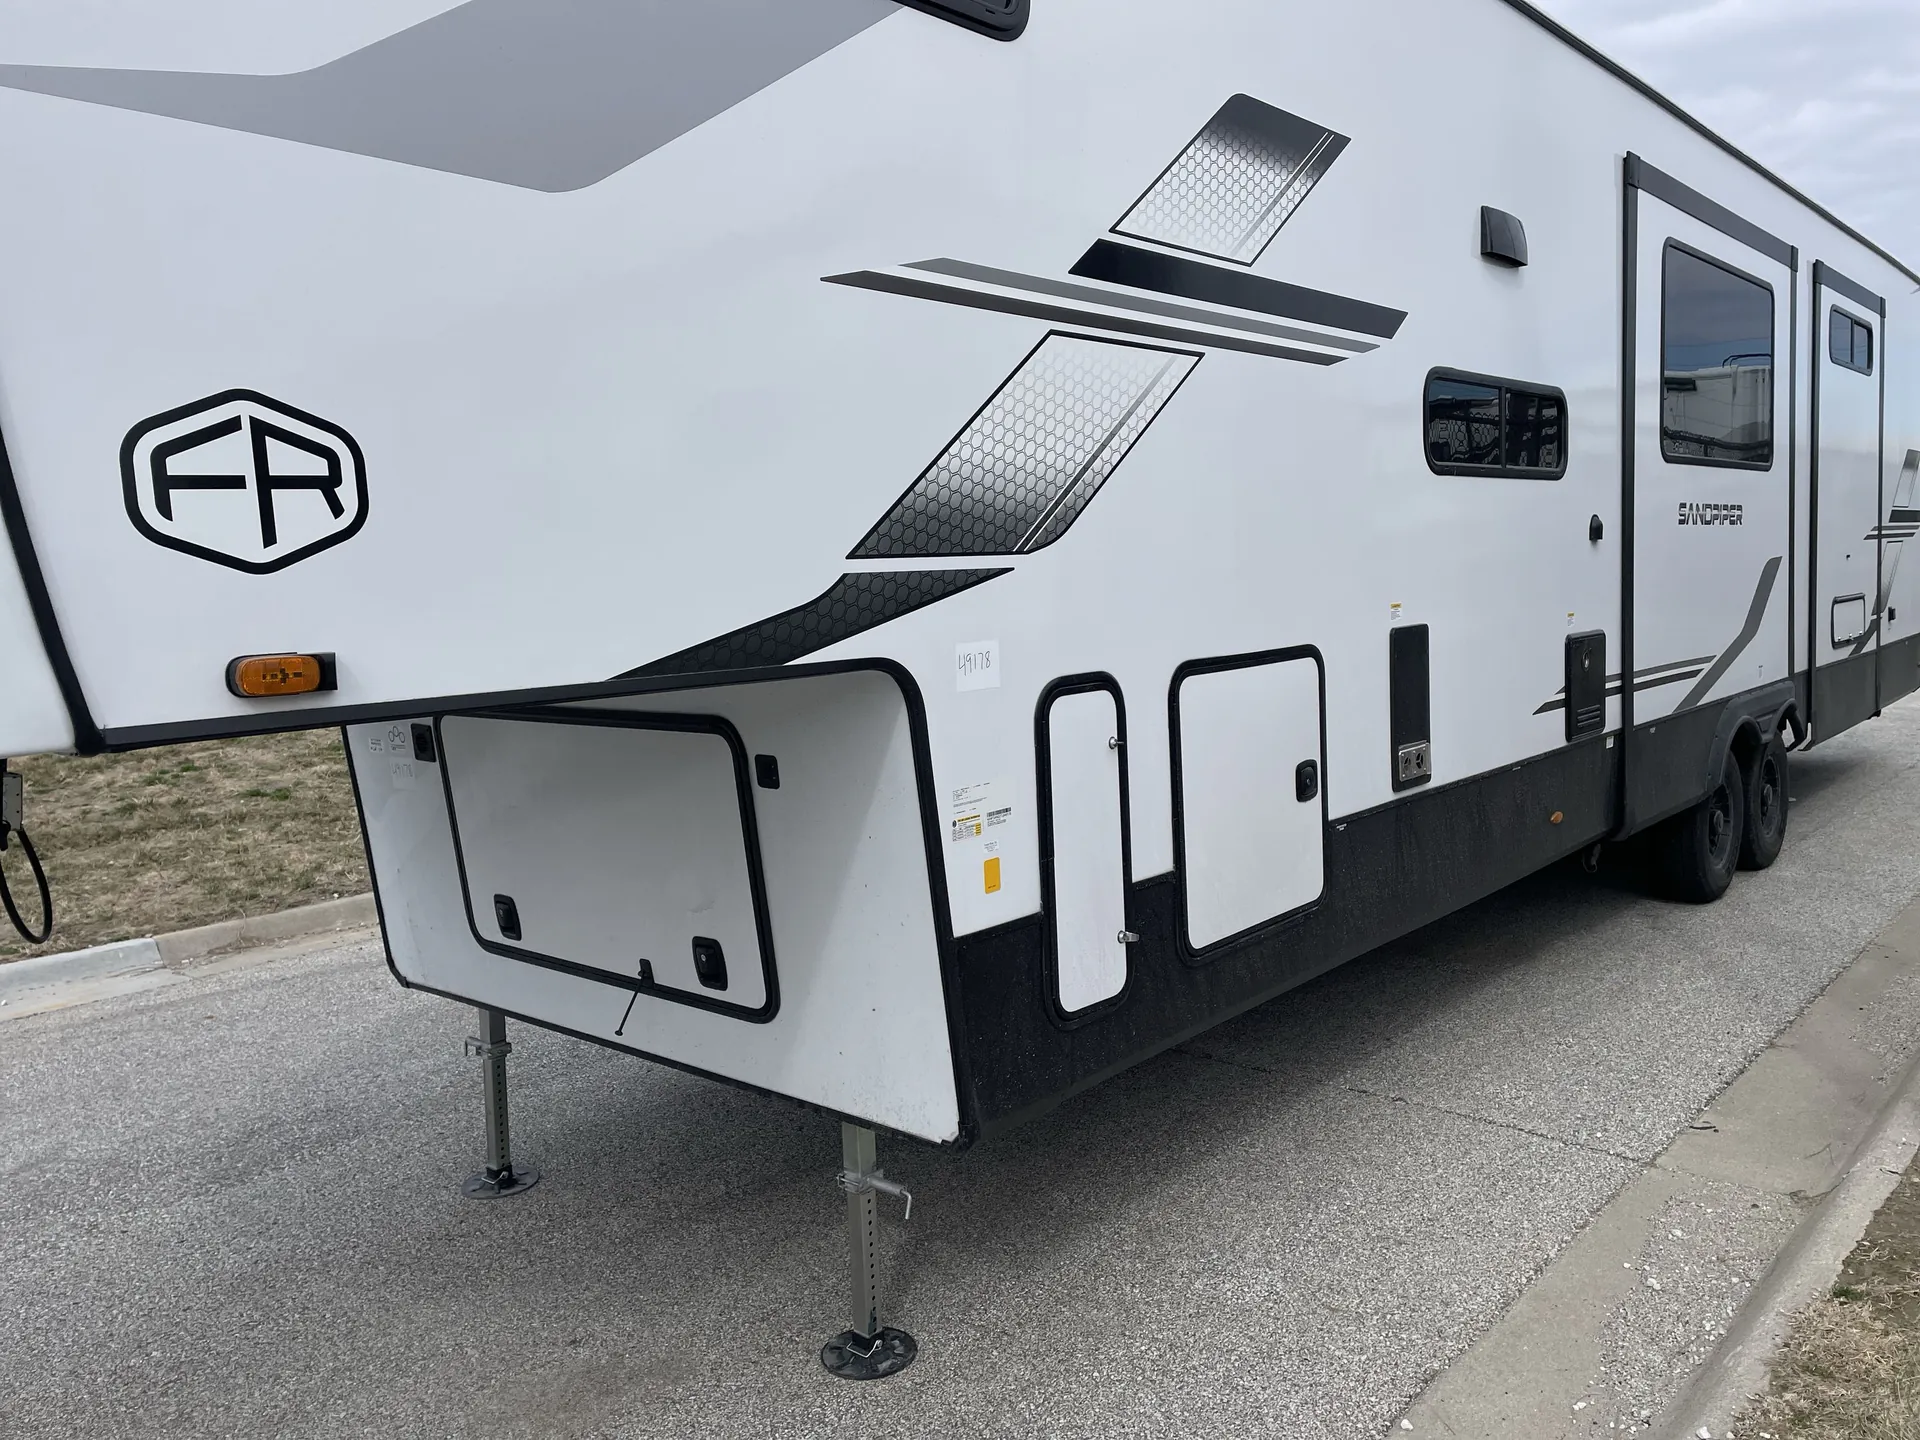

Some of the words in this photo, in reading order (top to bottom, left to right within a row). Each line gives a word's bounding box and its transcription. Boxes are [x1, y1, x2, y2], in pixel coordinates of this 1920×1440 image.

[150, 414, 345, 549] FR
[1678, 502, 1743, 526] SANDPIPER
[958, 650, 991, 676] 49178
